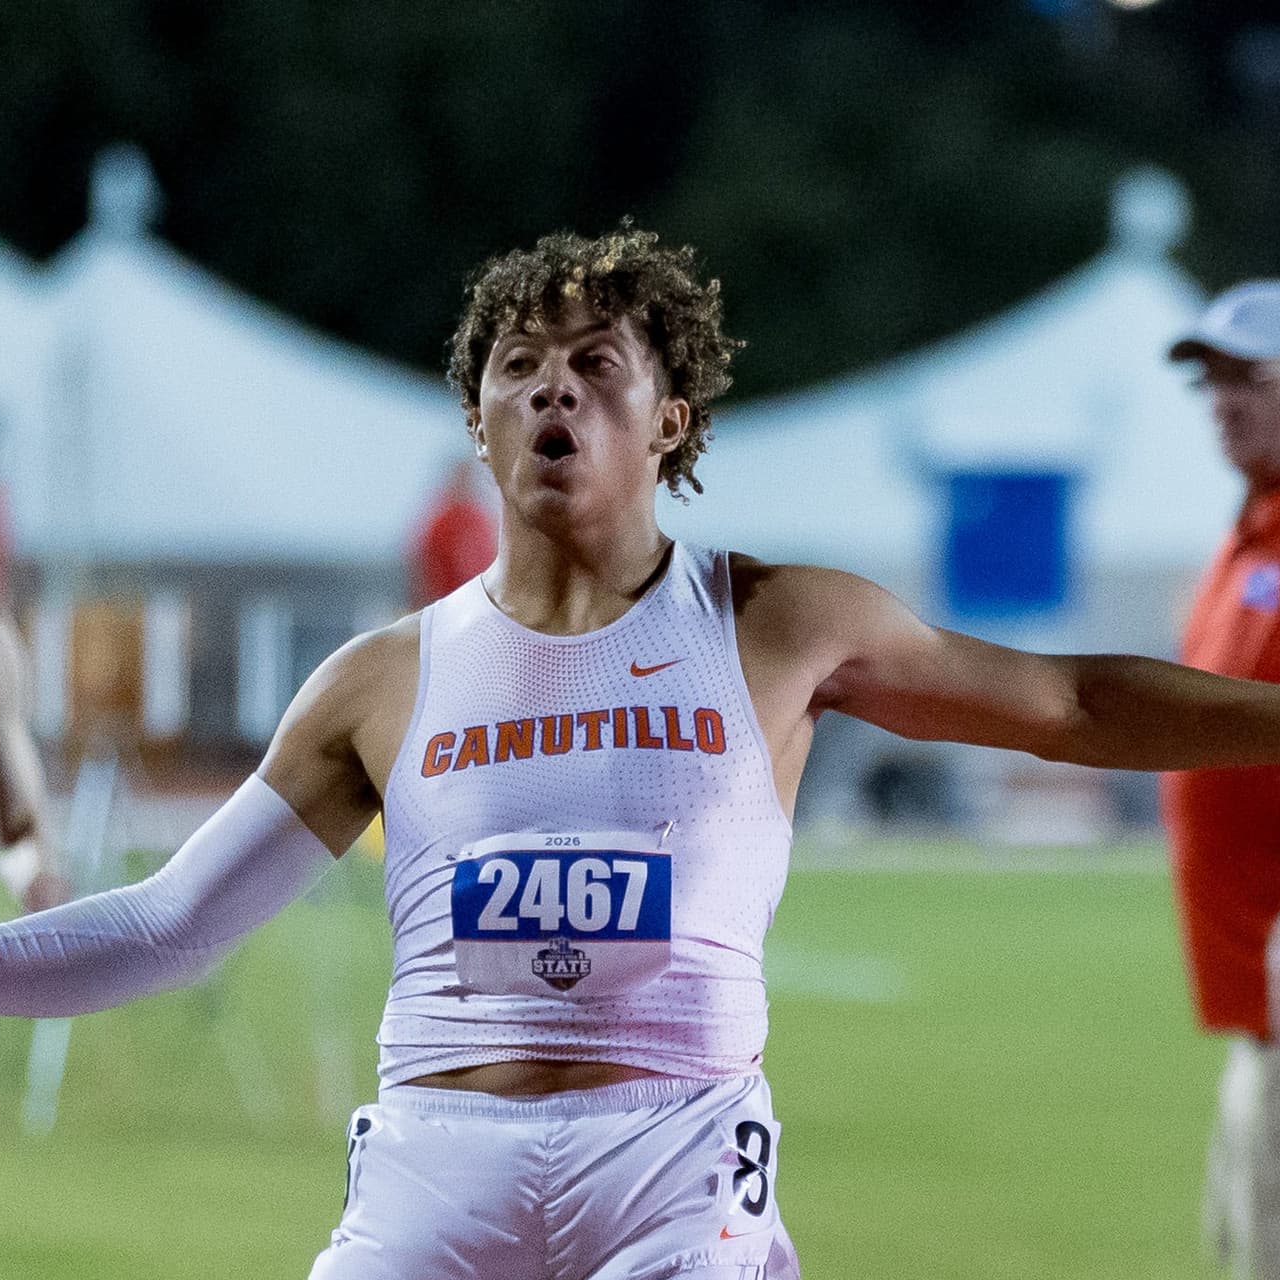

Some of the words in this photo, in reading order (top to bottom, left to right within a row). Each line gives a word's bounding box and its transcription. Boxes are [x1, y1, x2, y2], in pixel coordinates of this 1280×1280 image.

[421, 706, 726, 778] CANUTILLO
[545, 836, 581, 847] 2026
[477, 858, 648, 932] 2467
[532, 959, 591, 974] STATE
